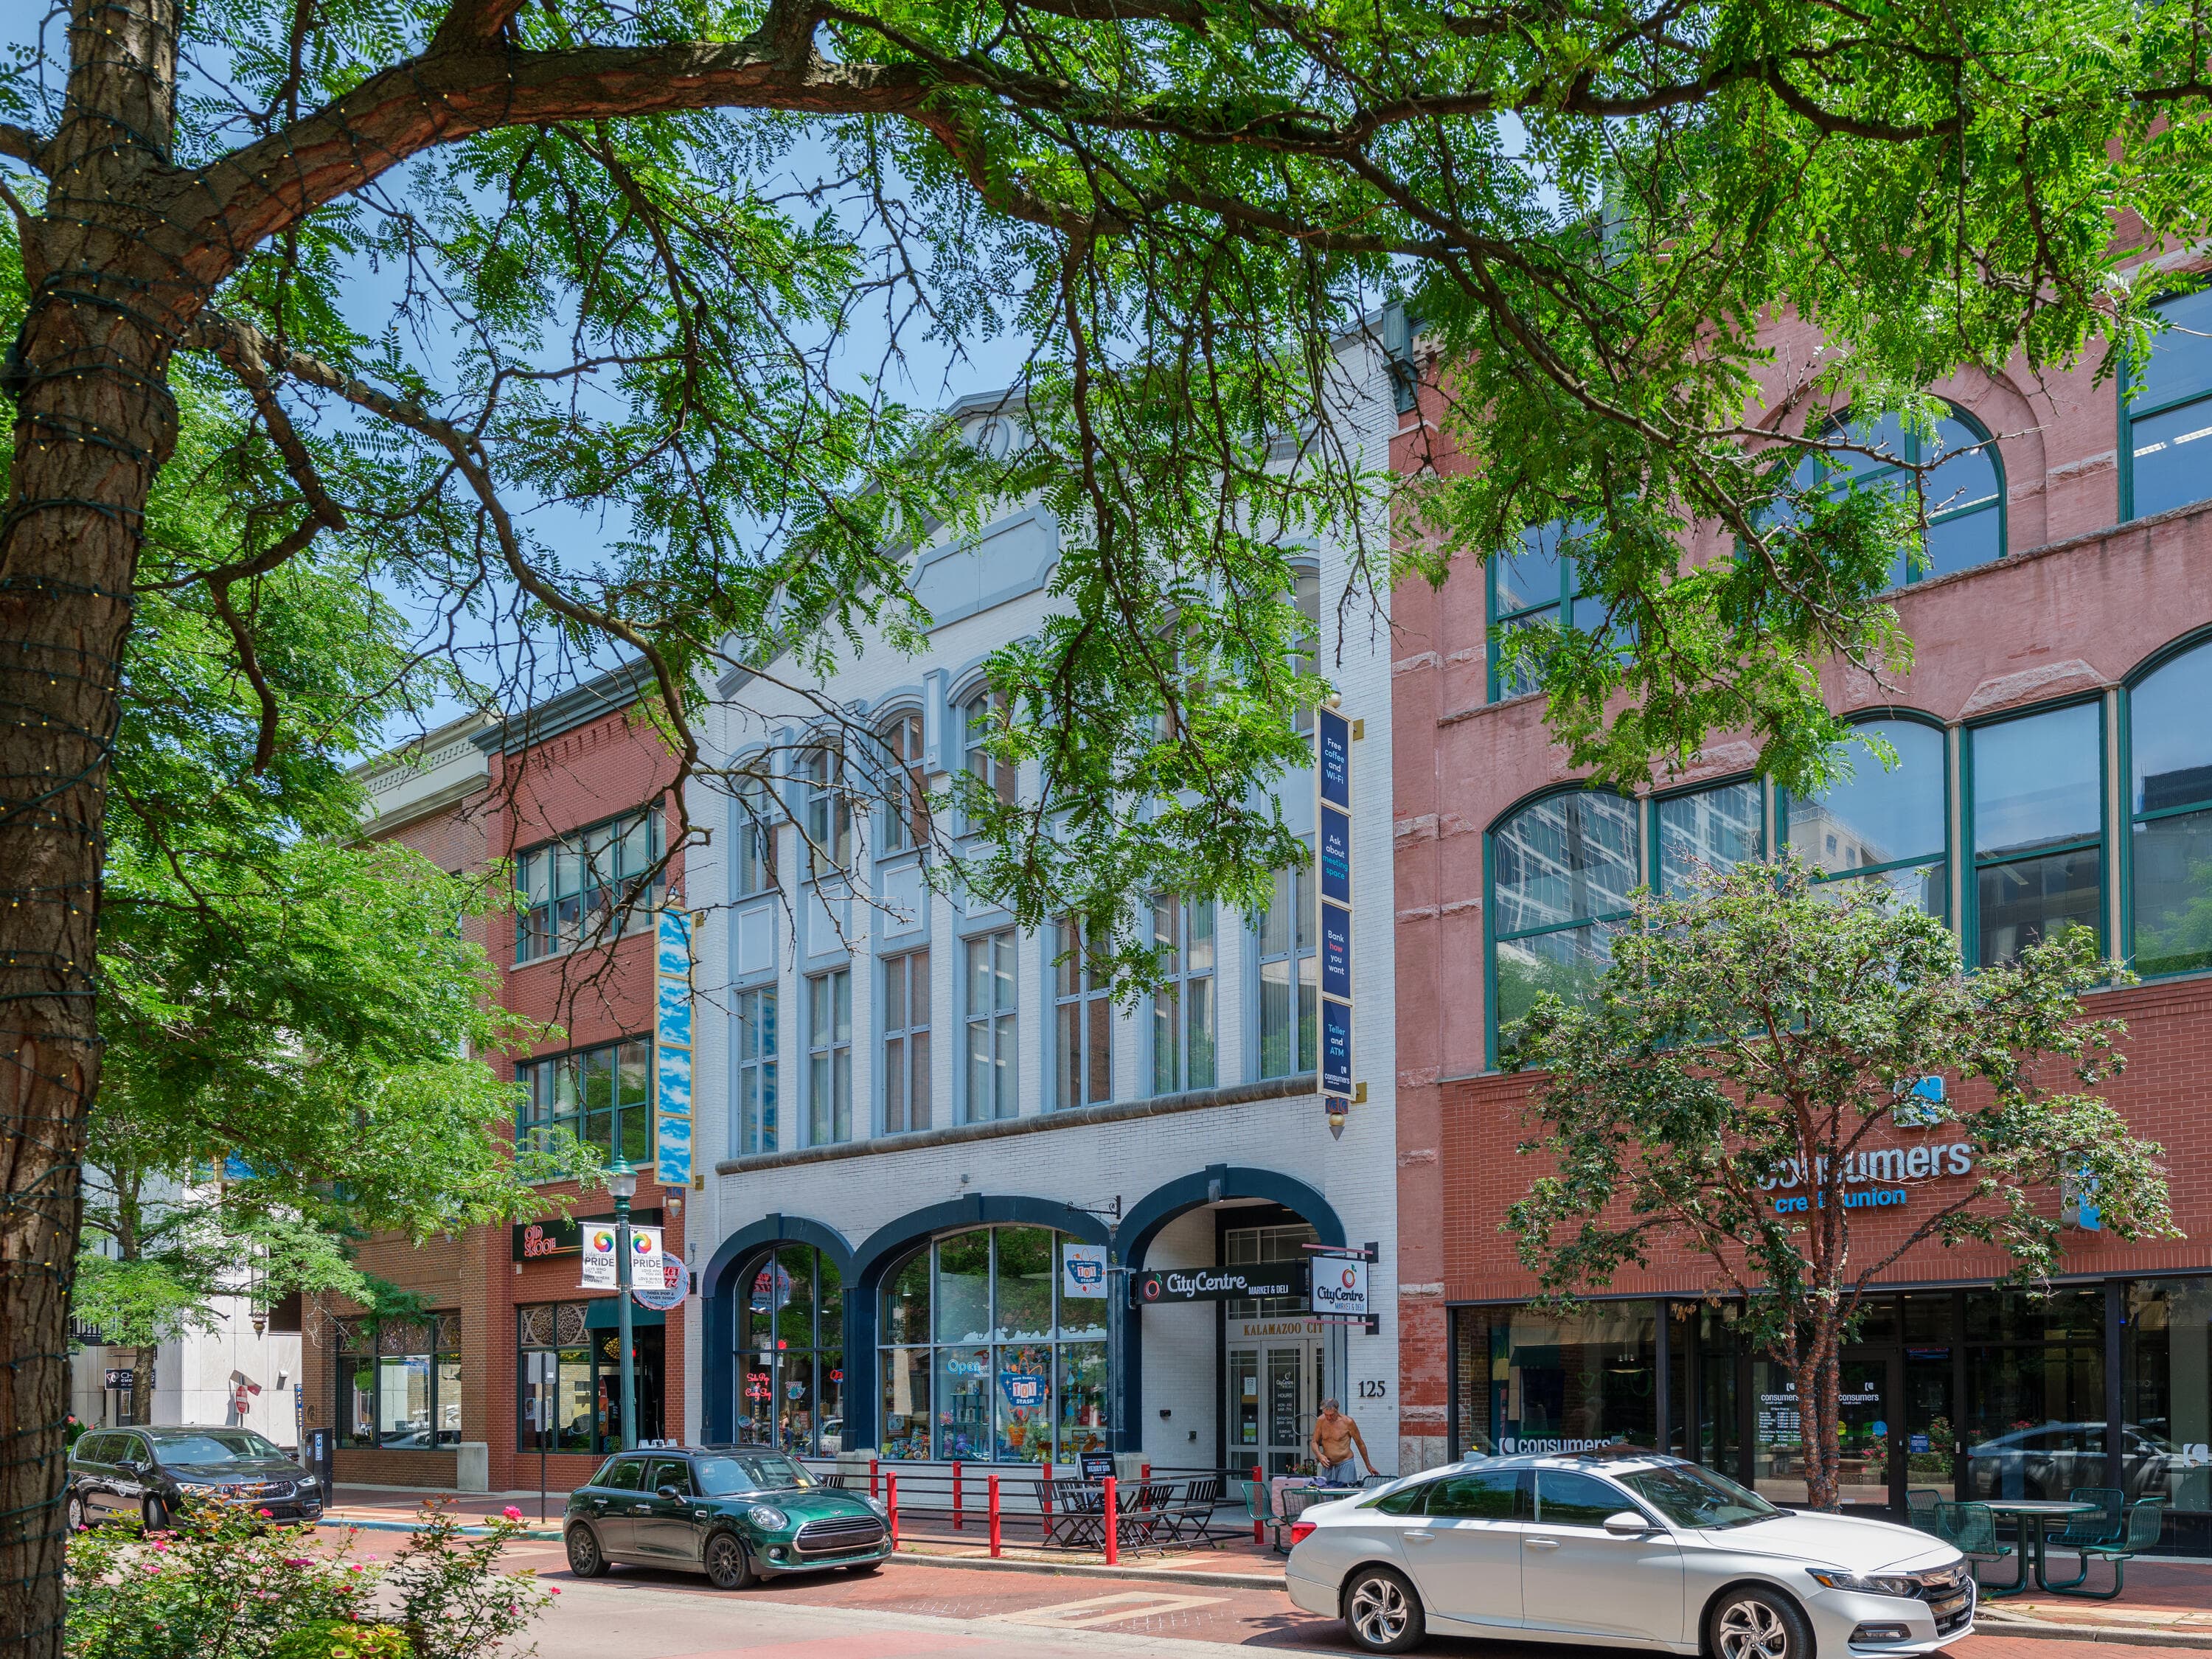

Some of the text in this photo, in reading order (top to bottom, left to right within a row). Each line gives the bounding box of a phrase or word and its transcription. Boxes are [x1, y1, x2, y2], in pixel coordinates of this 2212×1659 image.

[1327, 737, 1342, 751] Free
[1324, 749, 1345, 763] coffee
[1328, 762, 1341, 773] and
[1326, 770, 1344, 785] Wi-Fi
[1329, 835, 1341, 846] Ask
[1326, 845, 1345, 858] about
[1322, 855, 1349, 872] meeting
[1326, 867, 1345, 880] space
[1328, 931, 1344, 943] Bank
[1329, 941, 1343, 953] how
[1330, 954, 1342, 964] you
[1329, 964, 1344, 975] want
[1328, 1023, 1346, 1035] Teller
[1331, 1037, 1343, 1046] and
[1329, 1046, 1344, 1057] ATM
[1324, 1073, 1350, 1085] consumers
[1843, 1187, 1907, 1208] union
[585, 1256, 614, 1267] PRIDE
[633, 1259, 661, 1267] PRIDE
[1078, 1267, 1096, 1277] TOY
[1167, 1271, 1248, 1298] CityCentre
[1248, 1284, 1288, 1295] MARKET & DELI
[1317, 1285, 1365, 1304] CityCentre
[1335, 1302, 1351, 1310] MARKET
[1355, 1303, 1364, 1311] DELI
[1243, 1322, 1323, 1336] KALAMAZOO CIT
[947, 1359, 981, 1376] Open
[1013, 1382, 1036, 1397] TOY
[1358, 1380, 1385, 1397] 125
[1838, 1394, 1879, 1402] consumers
[1517, 1439, 1611, 1454] consumers
